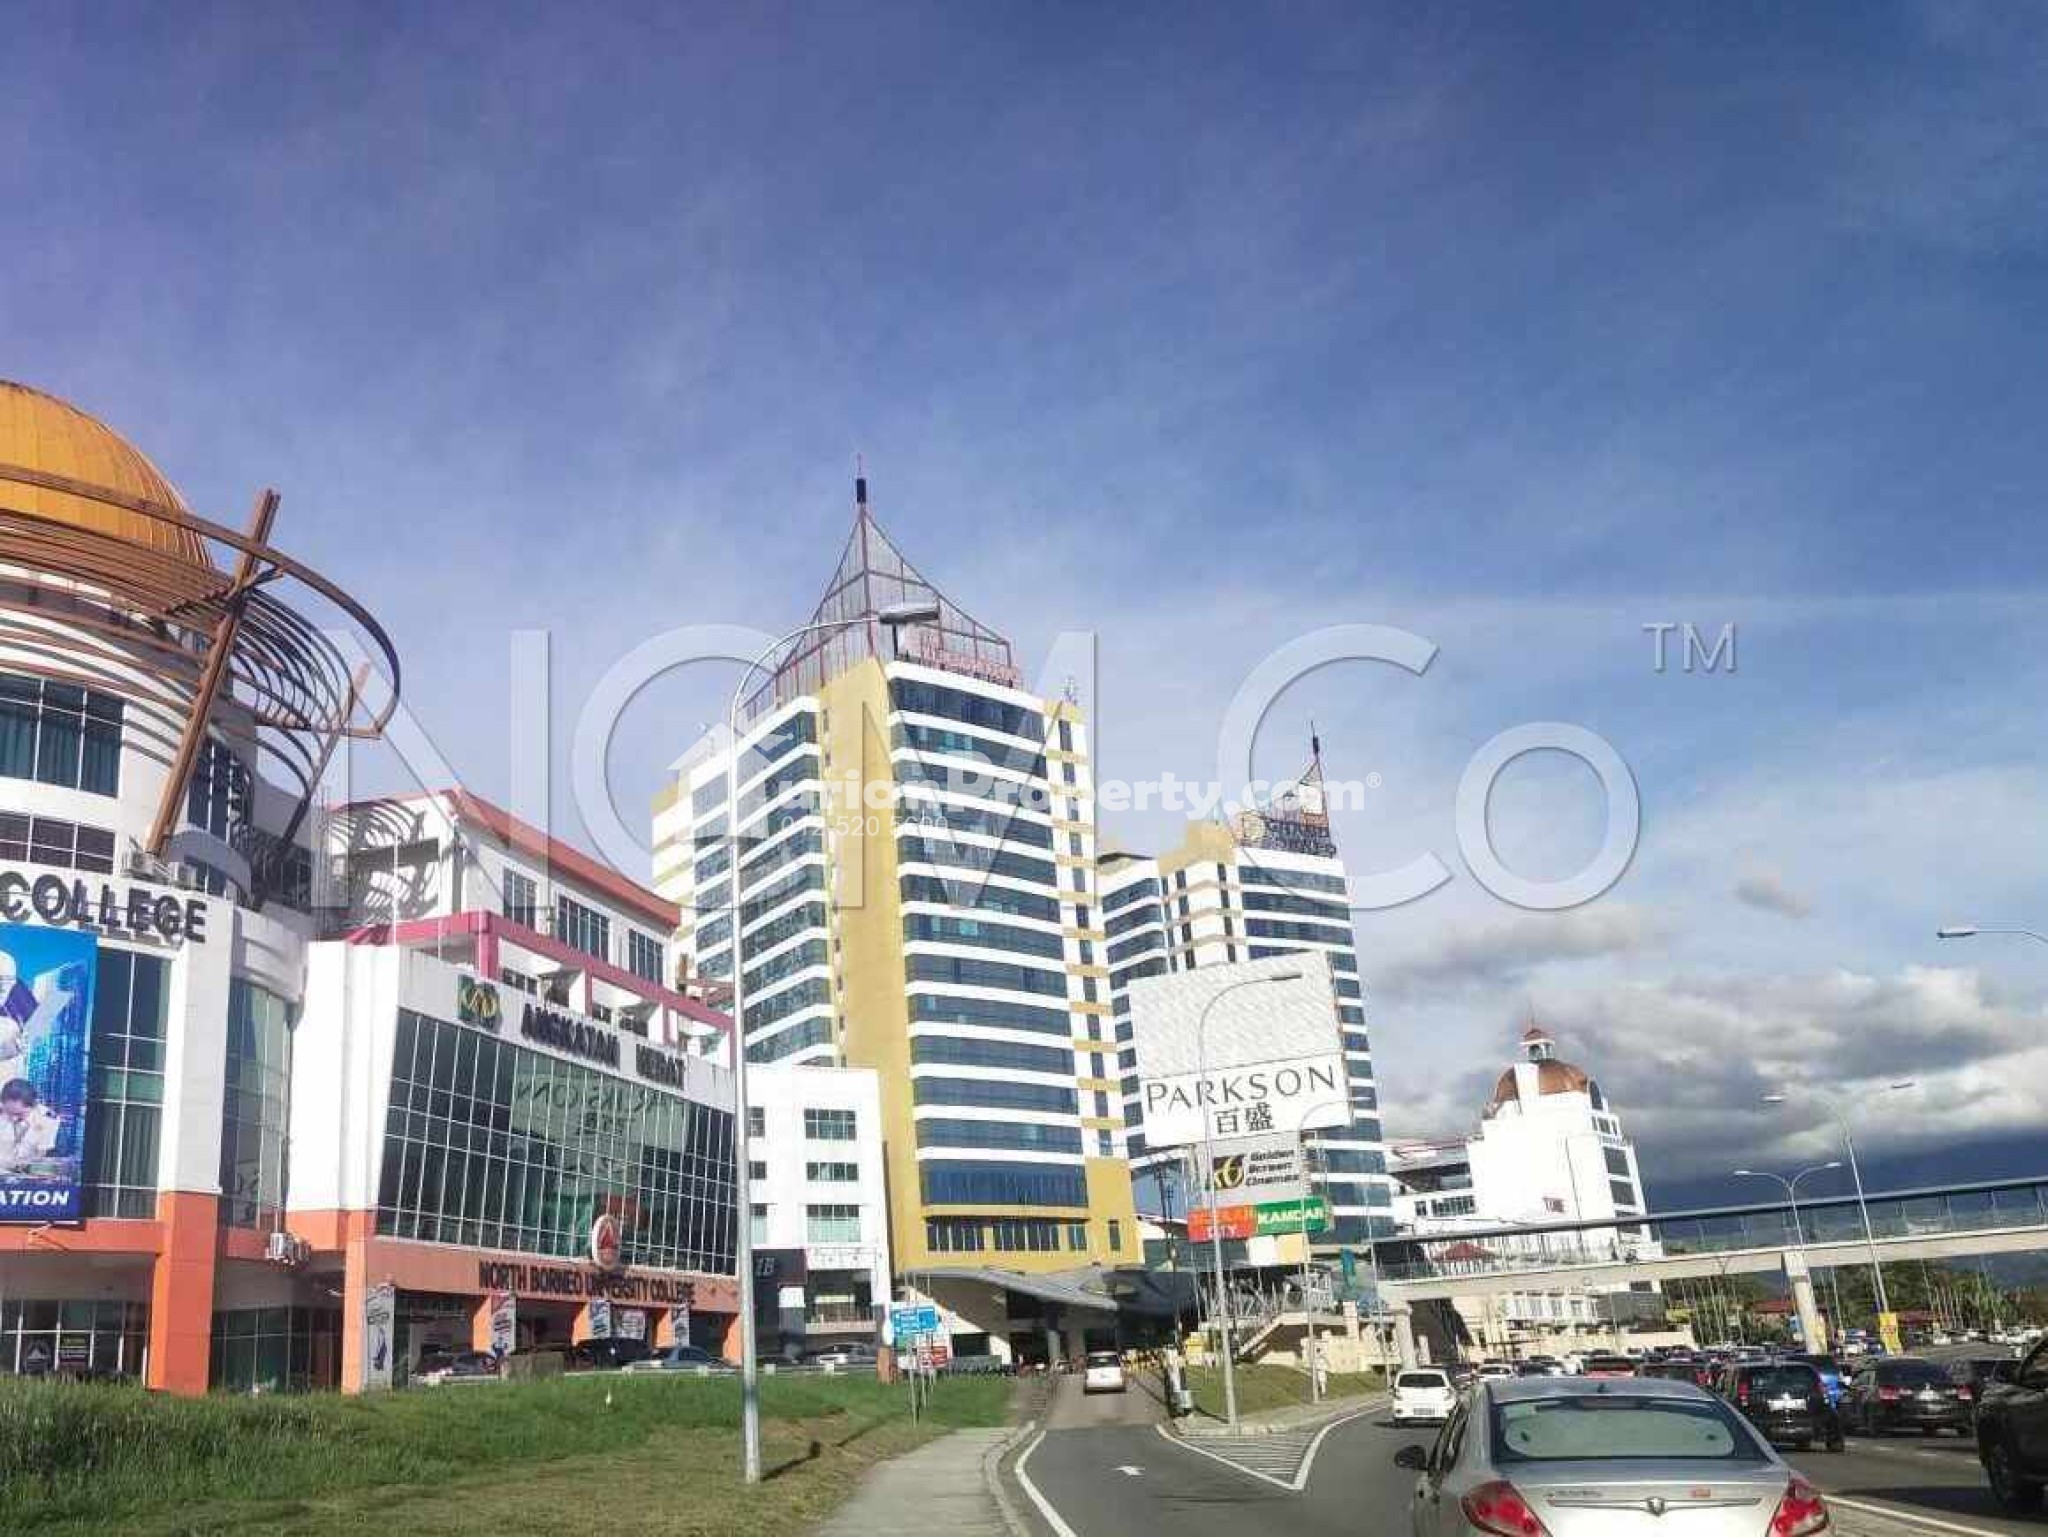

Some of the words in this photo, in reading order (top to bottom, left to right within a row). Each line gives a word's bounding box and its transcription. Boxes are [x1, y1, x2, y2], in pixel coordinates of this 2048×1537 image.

[0, 871, 207, 945] COLLEGE
[1145, 1064, 1336, 1113] PARKSON
[1212, 1101, 1275, 1135] 百盛
[478, 1260, 527, 1291] NORTH
[529, 1265, 583, 1296] BORNEO
[585, 1271, 649, 1302] UNIVERSITY
[650, 1277, 696, 1305] COLLEGE
